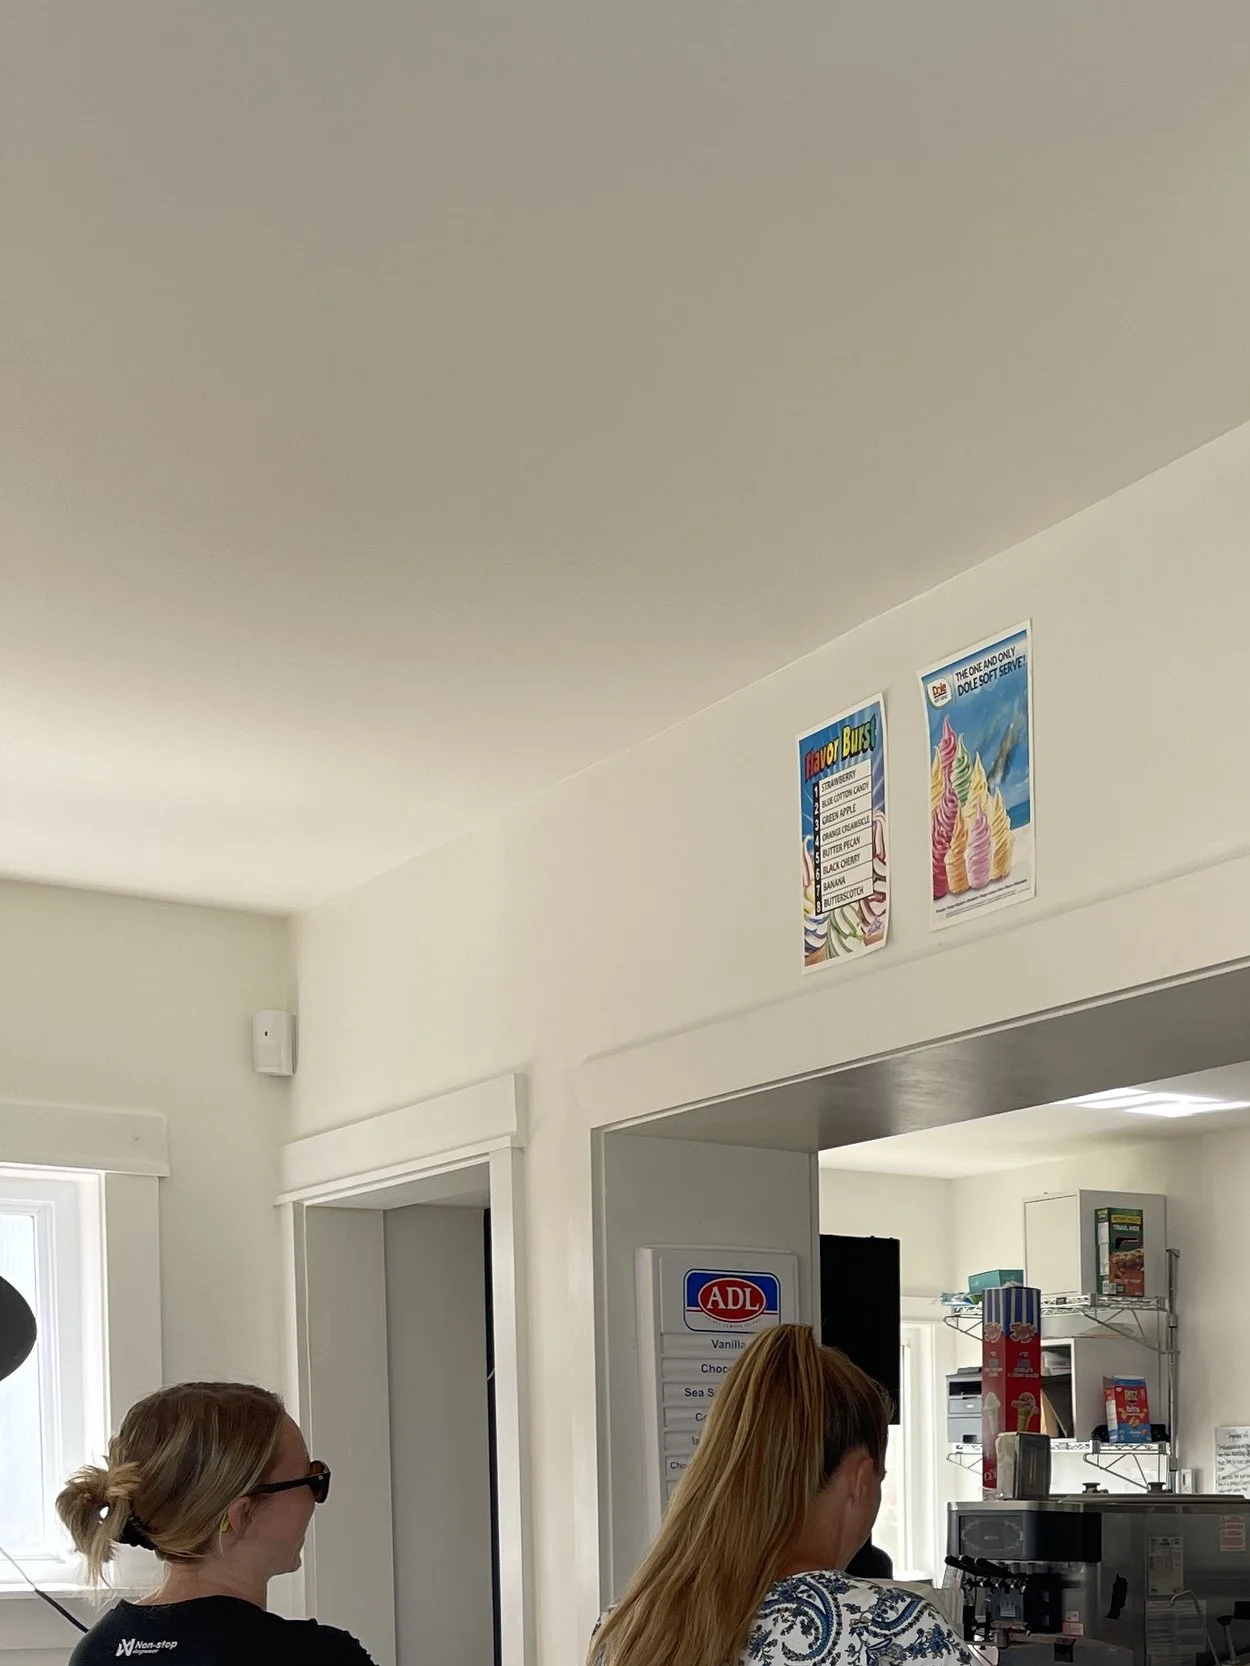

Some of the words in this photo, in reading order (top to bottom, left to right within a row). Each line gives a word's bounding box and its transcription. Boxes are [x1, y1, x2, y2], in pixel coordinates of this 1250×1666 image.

[955, 670, 969, 682] THE
[969, 662, 983, 676] ONE
[984, 656, 998, 670] AND
[998, 646, 1016, 662] ONLY
[957, 677, 978, 696] DOLE
[979, 668, 999, 686] SOFT
[999, 654, 1026, 677] SERVE!
[821, 770, 856, 792] STRAWBERRY
[840, 804, 856, 817] APPLE
[823, 876, 846, 891] BANANA
[706, 1286, 760, 1311] ADL
[711, 1340, 746, 1349] Vanilla
[685, 1388, 704, 1397] Sea
[135, 1640, 178, 1650] Non-stop
